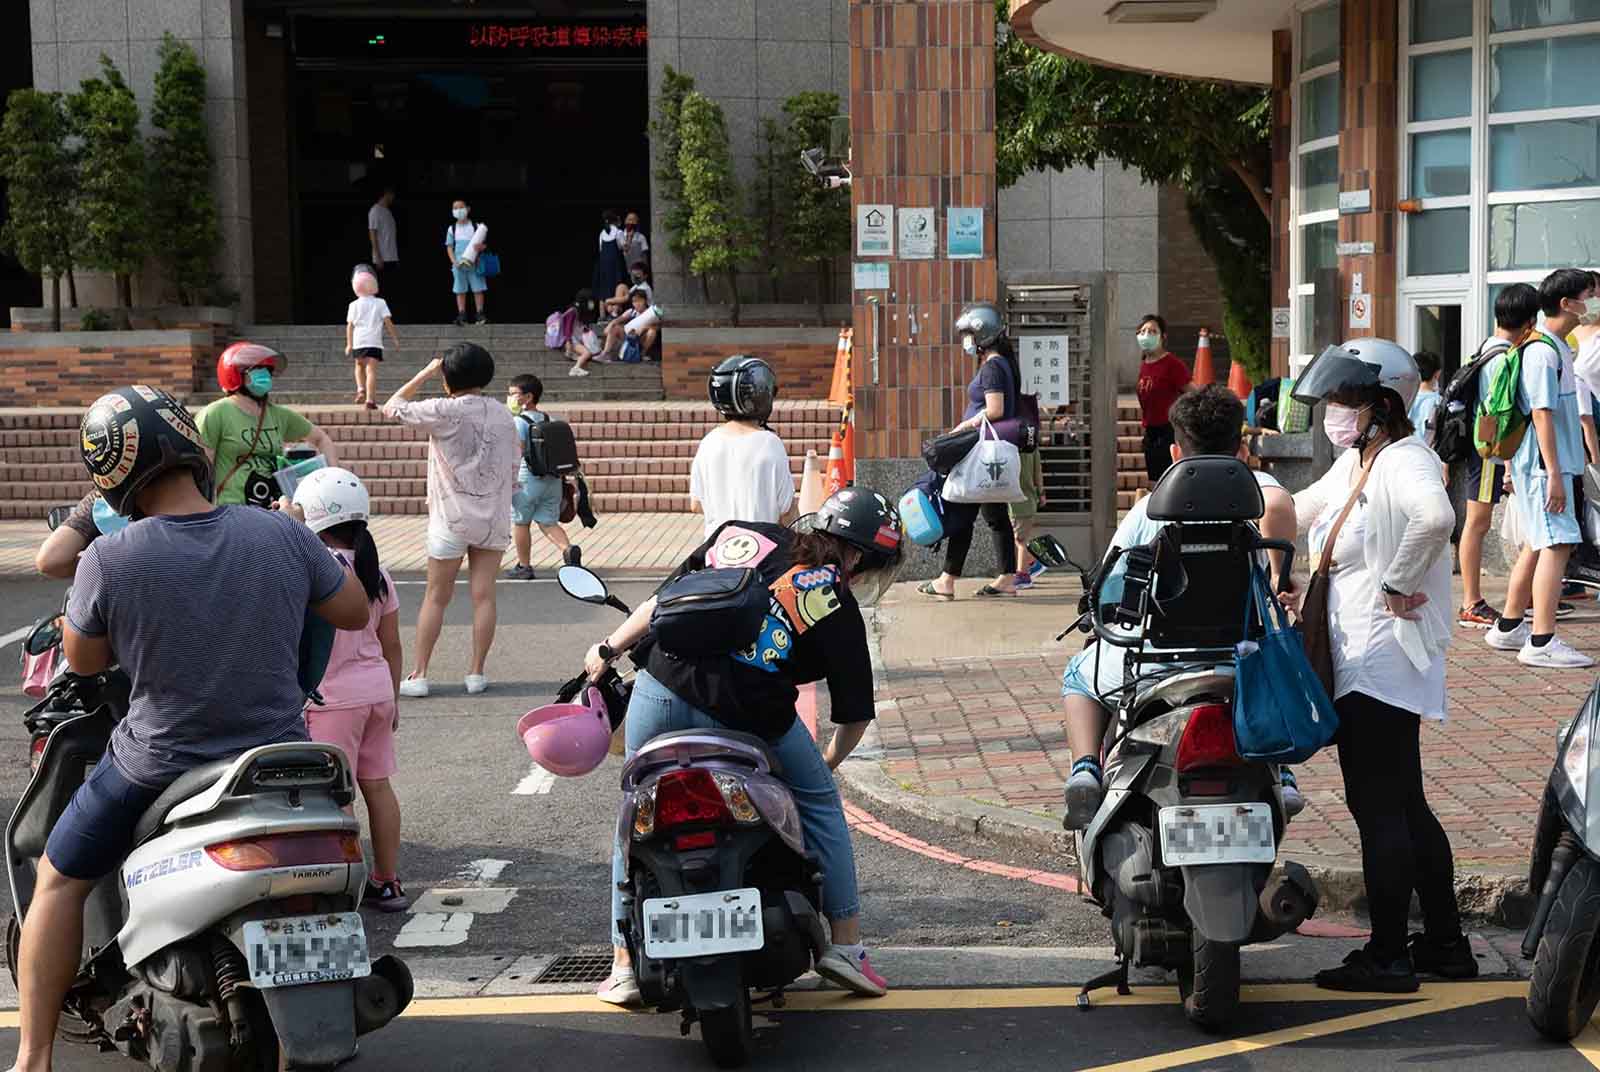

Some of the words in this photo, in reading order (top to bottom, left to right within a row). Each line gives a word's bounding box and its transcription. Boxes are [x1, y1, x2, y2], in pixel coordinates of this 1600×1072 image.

[127, 850, 204, 888] METZELER
[283, 919, 327, 934] 台北市
